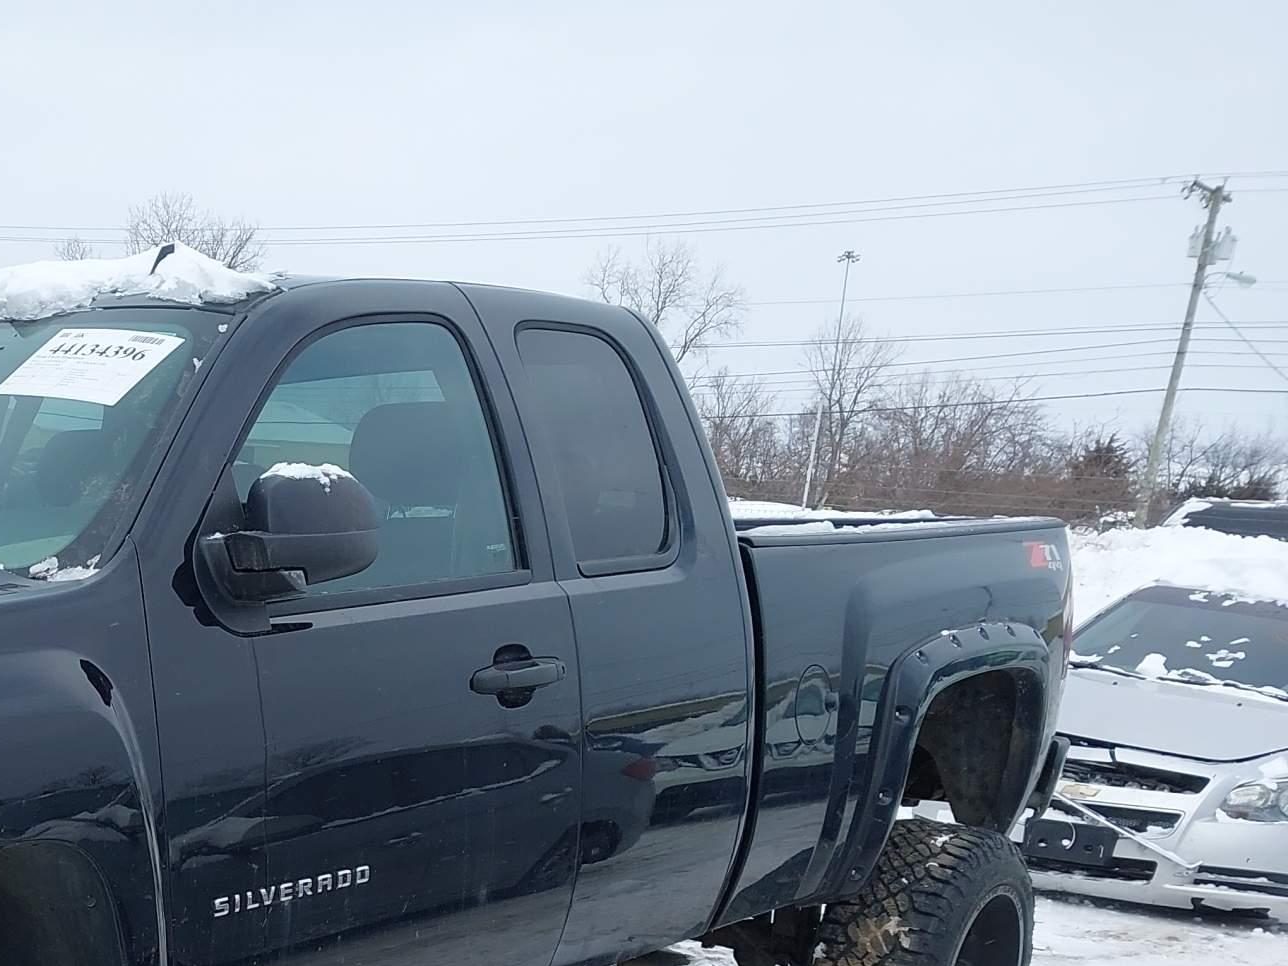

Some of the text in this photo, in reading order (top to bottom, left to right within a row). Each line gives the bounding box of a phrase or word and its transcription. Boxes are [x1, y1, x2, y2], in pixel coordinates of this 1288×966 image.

[49, 341, 147, 361] 44134396
[1022, 540, 1061, 567] Z71
[213, 864, 371, 918] SILVERADO
